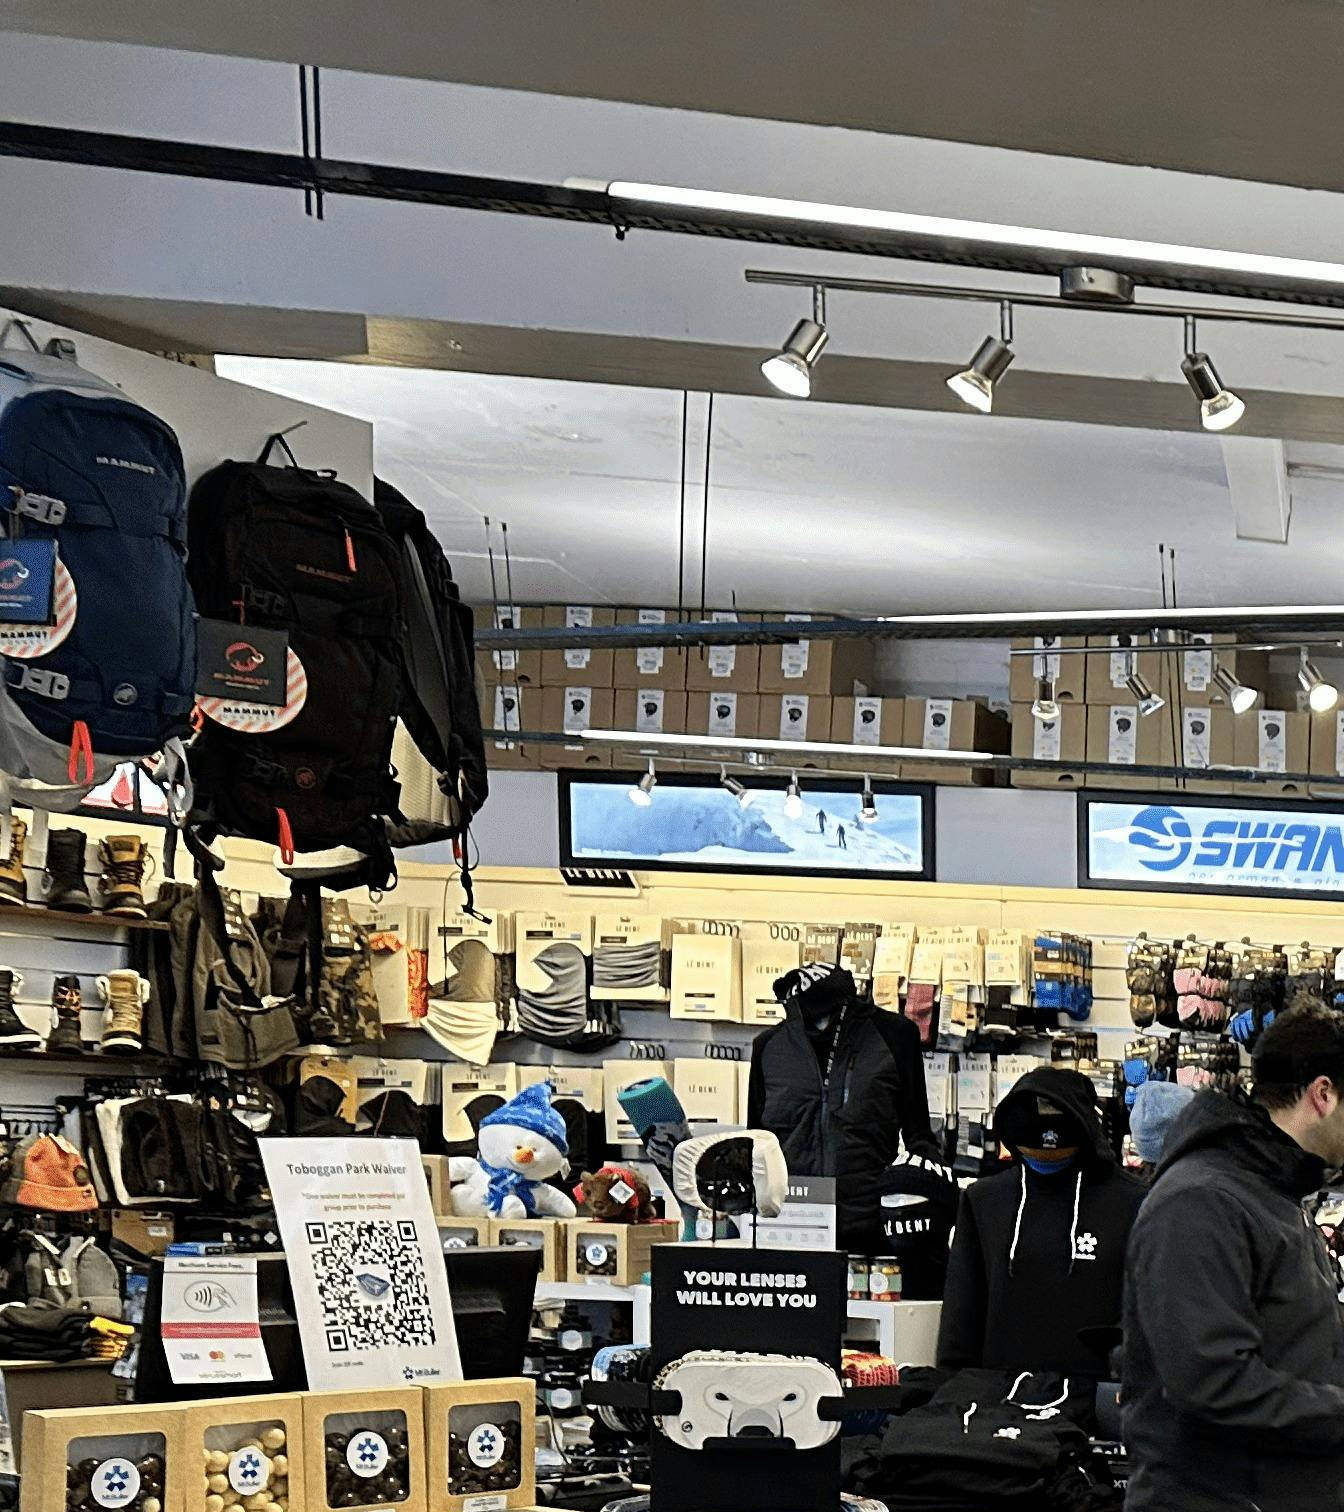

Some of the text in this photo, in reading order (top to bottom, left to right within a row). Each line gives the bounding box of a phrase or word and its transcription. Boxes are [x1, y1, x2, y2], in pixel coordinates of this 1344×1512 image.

[286, 1163, 407, 1177] Toboggan Park Waiver
[895, 1218, 930, 1235] DENT
[684, 1270, 807, 1288] YOUR LENSES
[676, 1290, 817, 1308] WILL LOVE YOU
